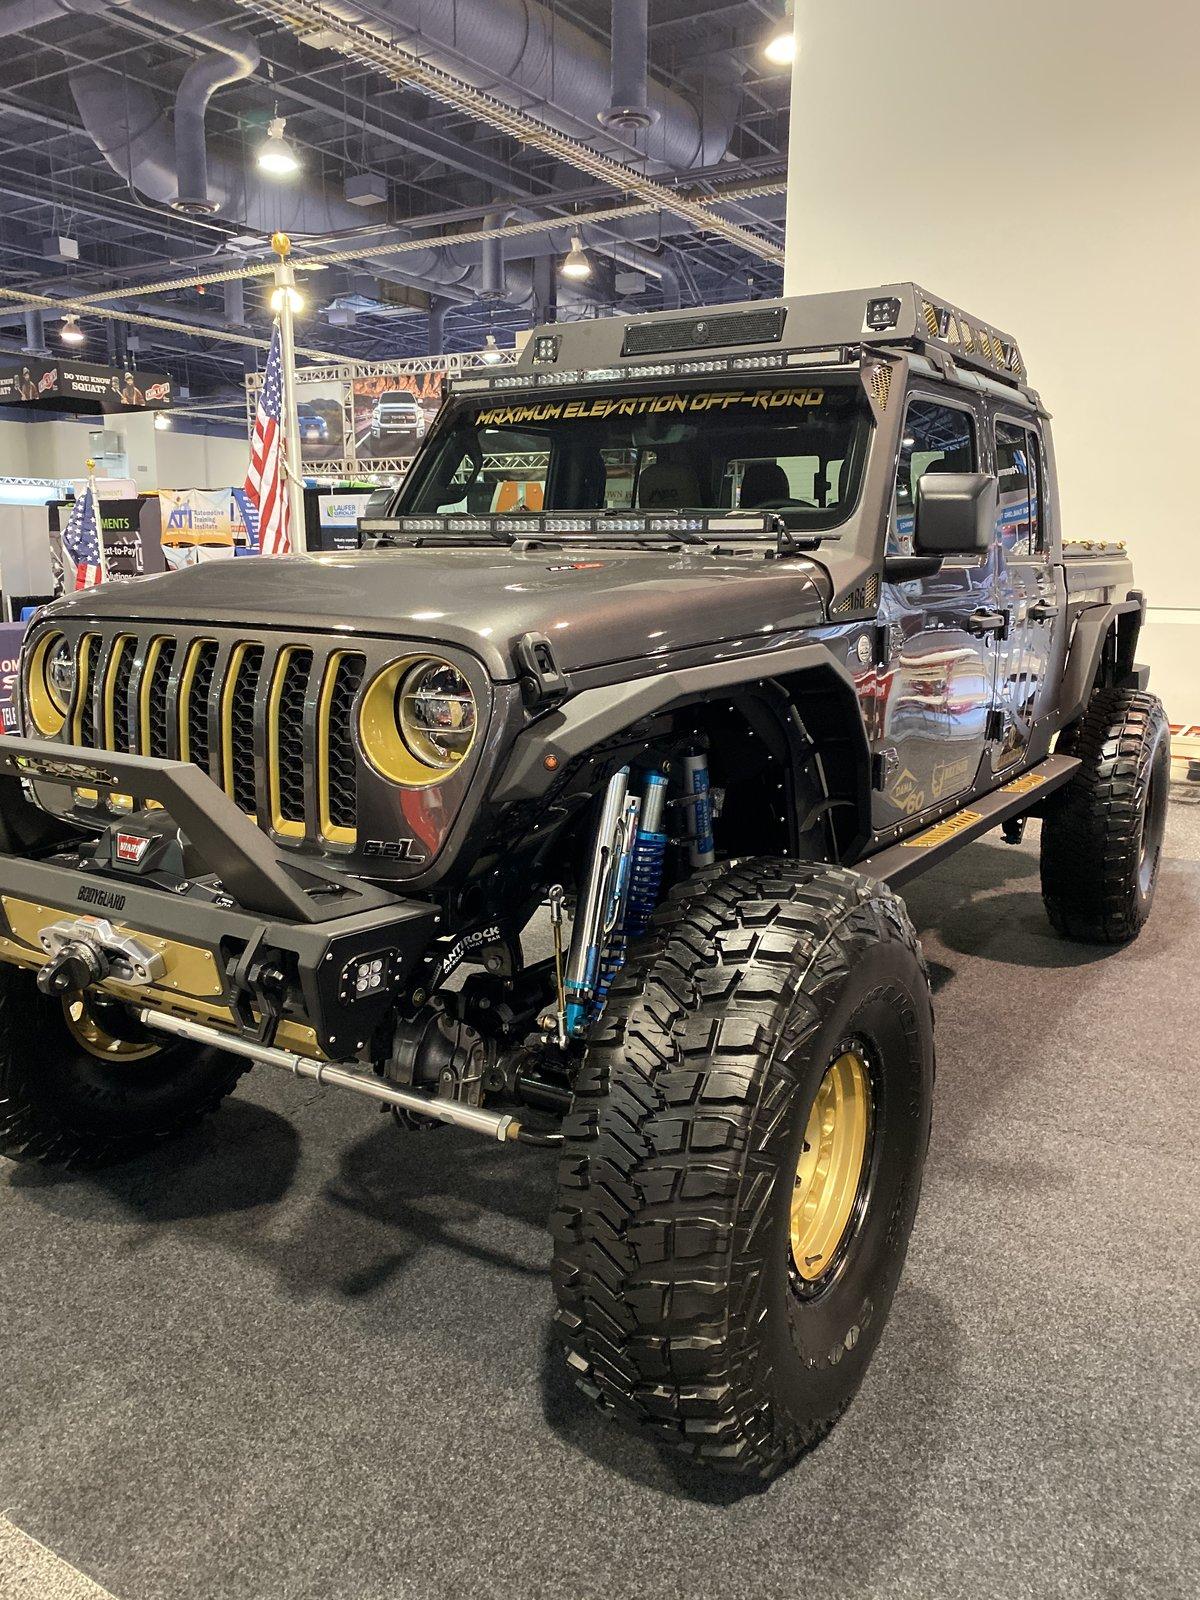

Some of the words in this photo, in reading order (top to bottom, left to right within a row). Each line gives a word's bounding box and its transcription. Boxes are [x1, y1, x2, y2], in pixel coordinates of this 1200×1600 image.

[72, 382, 107, 394] SQUAT?
[475, 405, 562, 427] MAXIMUM
[563, 393, 688, 419] ELEVATION
[689, 387, 825, 411] OFF-ROAD
[77, 885, 126, 911] BODYGUARD
[443, 926, 500, 970] ANTIROCK
